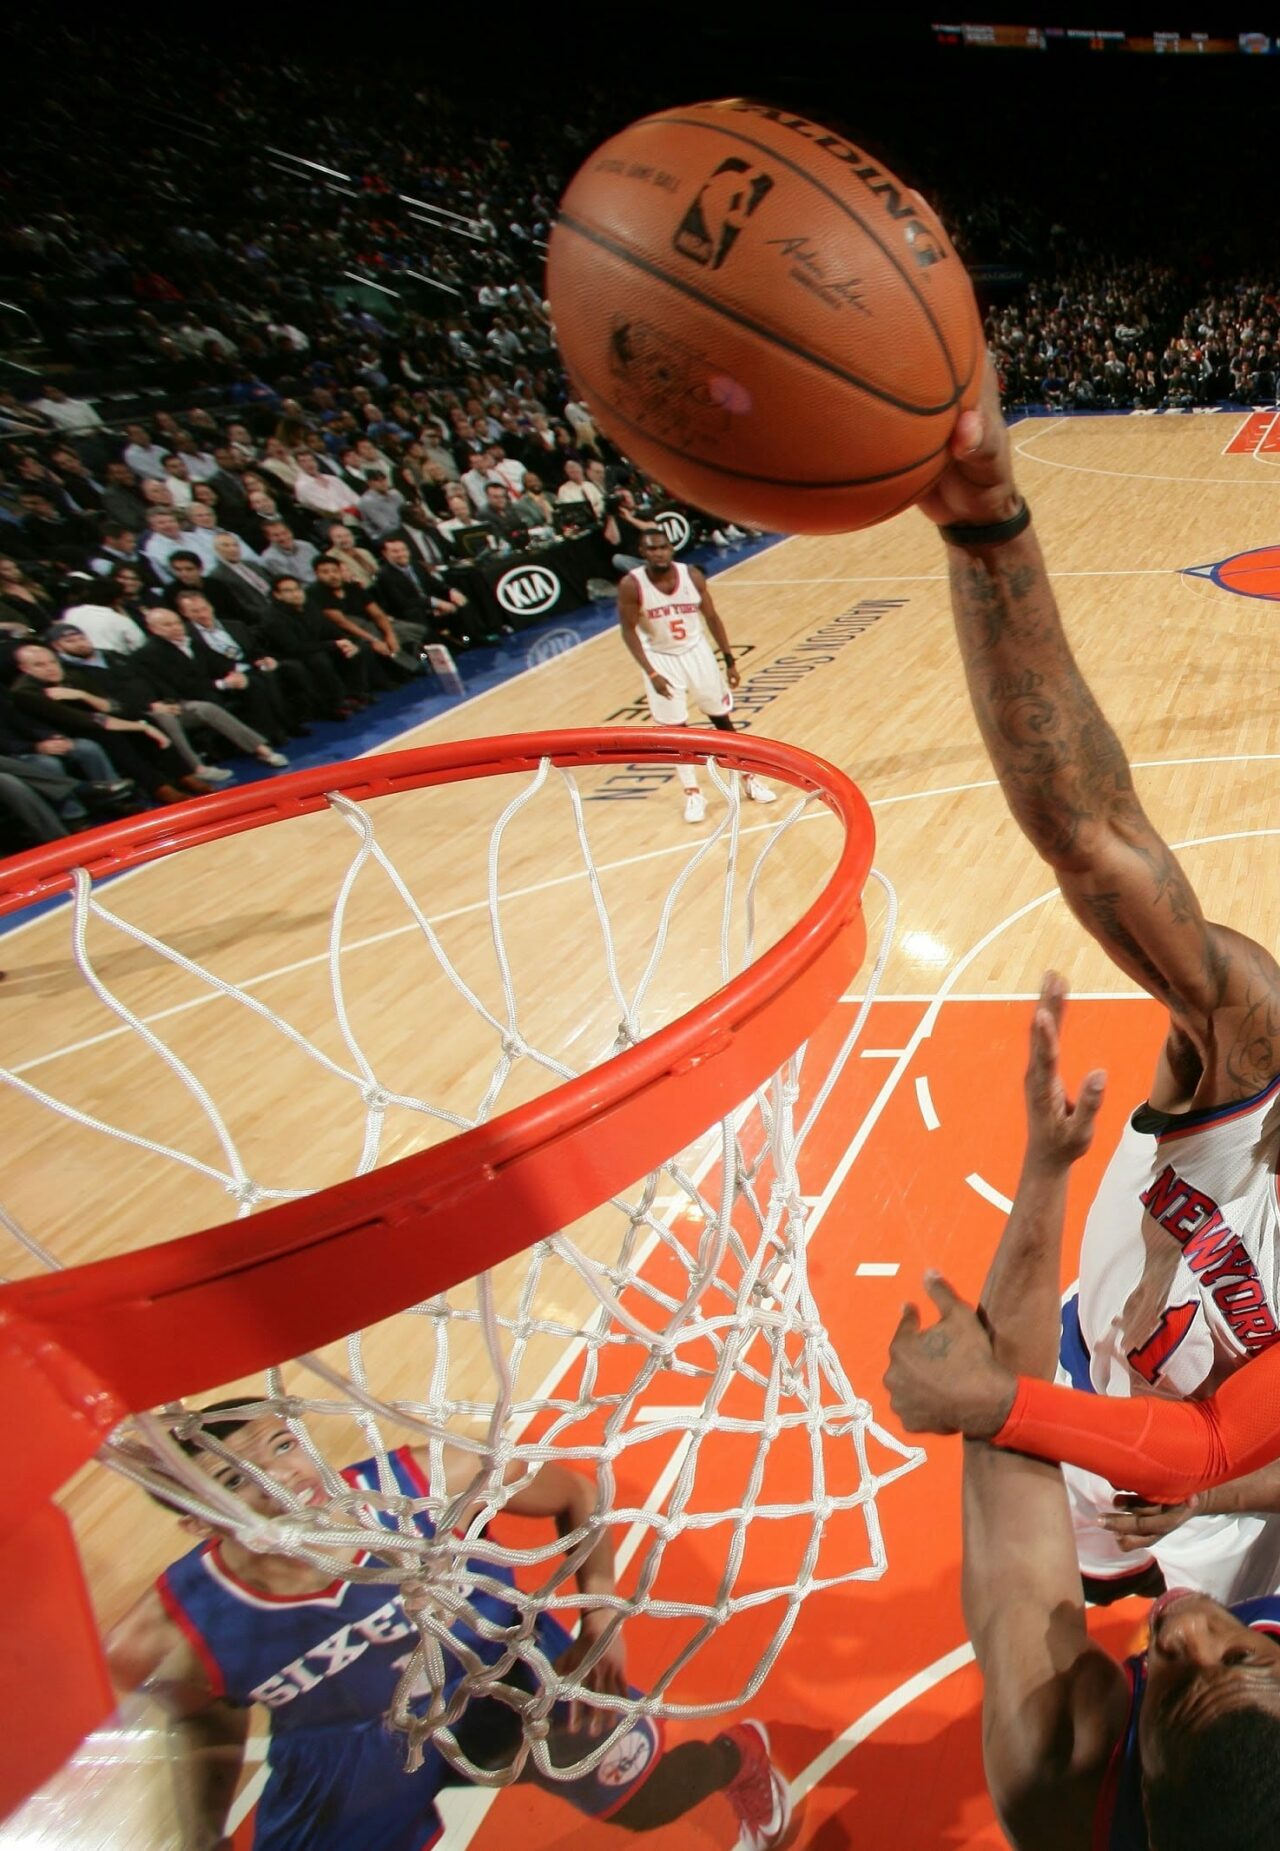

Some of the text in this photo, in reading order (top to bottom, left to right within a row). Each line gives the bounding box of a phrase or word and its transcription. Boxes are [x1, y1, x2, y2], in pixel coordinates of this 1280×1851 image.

[708, 104, 947, 267] ALDING
[1129, 406, 1223, 416] NEW
[505, 572, 554, 609] KIA
[669, 619, 687, 640] 5
[792, 599, 912, 652] MADISON
[1138, 1163, 1242, 1274] NEW
[1127, 1300, 1201, 1386] 1
